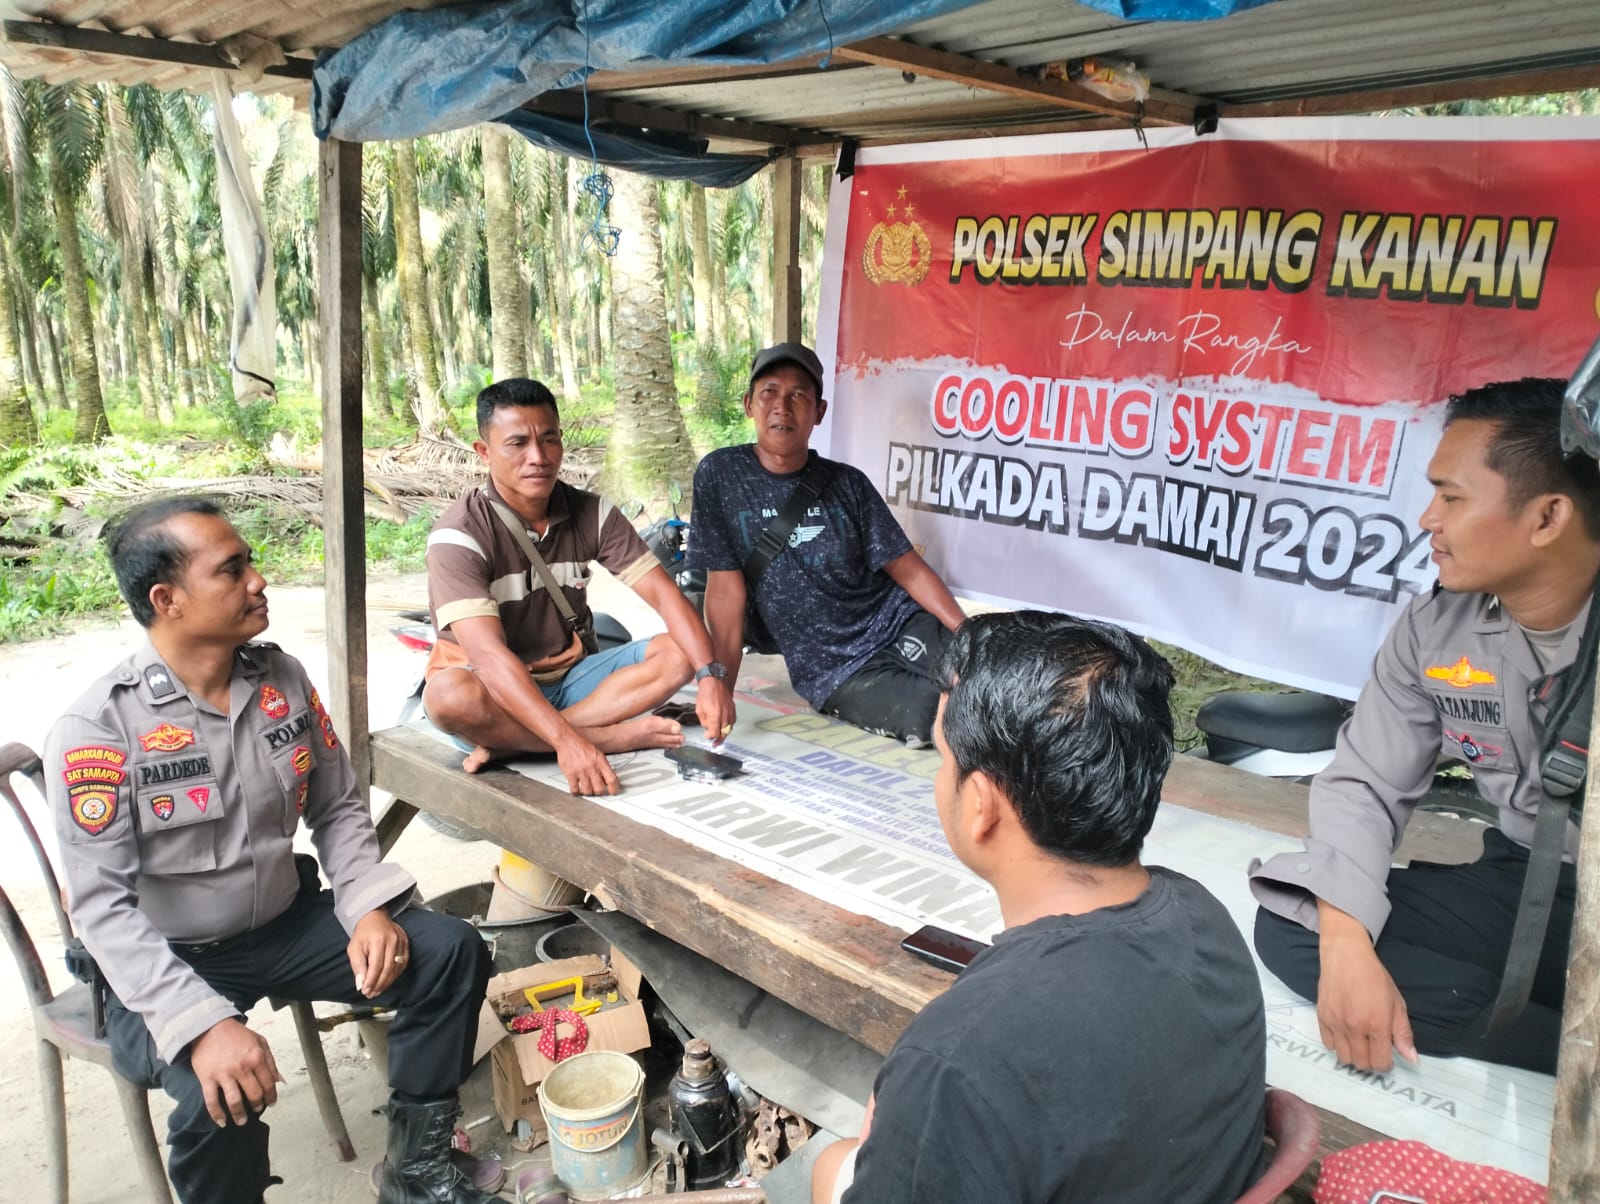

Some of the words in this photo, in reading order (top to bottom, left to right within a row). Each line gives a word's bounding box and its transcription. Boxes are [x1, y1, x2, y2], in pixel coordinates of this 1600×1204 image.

[949, 213, 1098, 286] POLSEK
[1097, 206, 1323, 293] SIMPANG
[1326, 210, 1558, 310] KANAN
[1059, 302, 1175, 350] Dalam
[1178, 309, 1312, 377] Rangka
[931, 372, 1158, 457] COOLING
[1166, 390, 1407, 499] SYSTEM
[887, 441, 1069, 535] PILKADA
[1078, 466, 1256, 573] DAMAI
[1253, 498, 1441, 603] 2024
[264, 713, 310, 750] POLRI
[66, 769, 83, 781] SAT
[82, 768, 120, 781] SAMAPTA
[141, 756, 211, 785] PARDEDE
[794, 751, 909, 790] DAPIL
[899, 783, 935, 799] 2
[658, 791, 843, 859] ARWI
[1266, 1033, 1328, 1064] RWI
